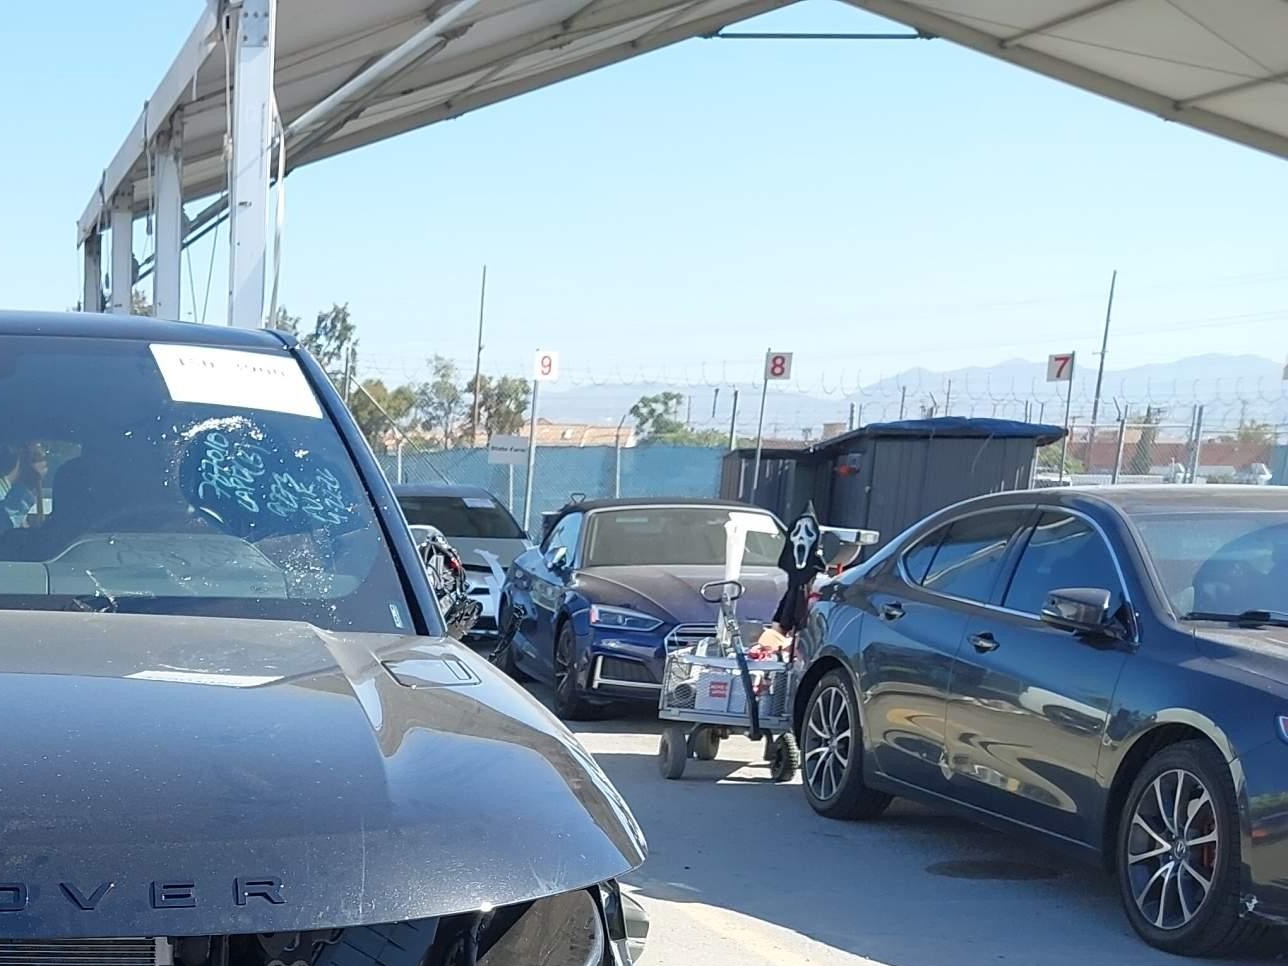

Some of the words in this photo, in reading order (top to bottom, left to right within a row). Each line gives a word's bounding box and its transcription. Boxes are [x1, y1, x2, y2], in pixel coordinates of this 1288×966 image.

[541, 355, 552, 376] 9
[770, 355, 786, 377] 8
[1054, 356, 1071, 379] 7
